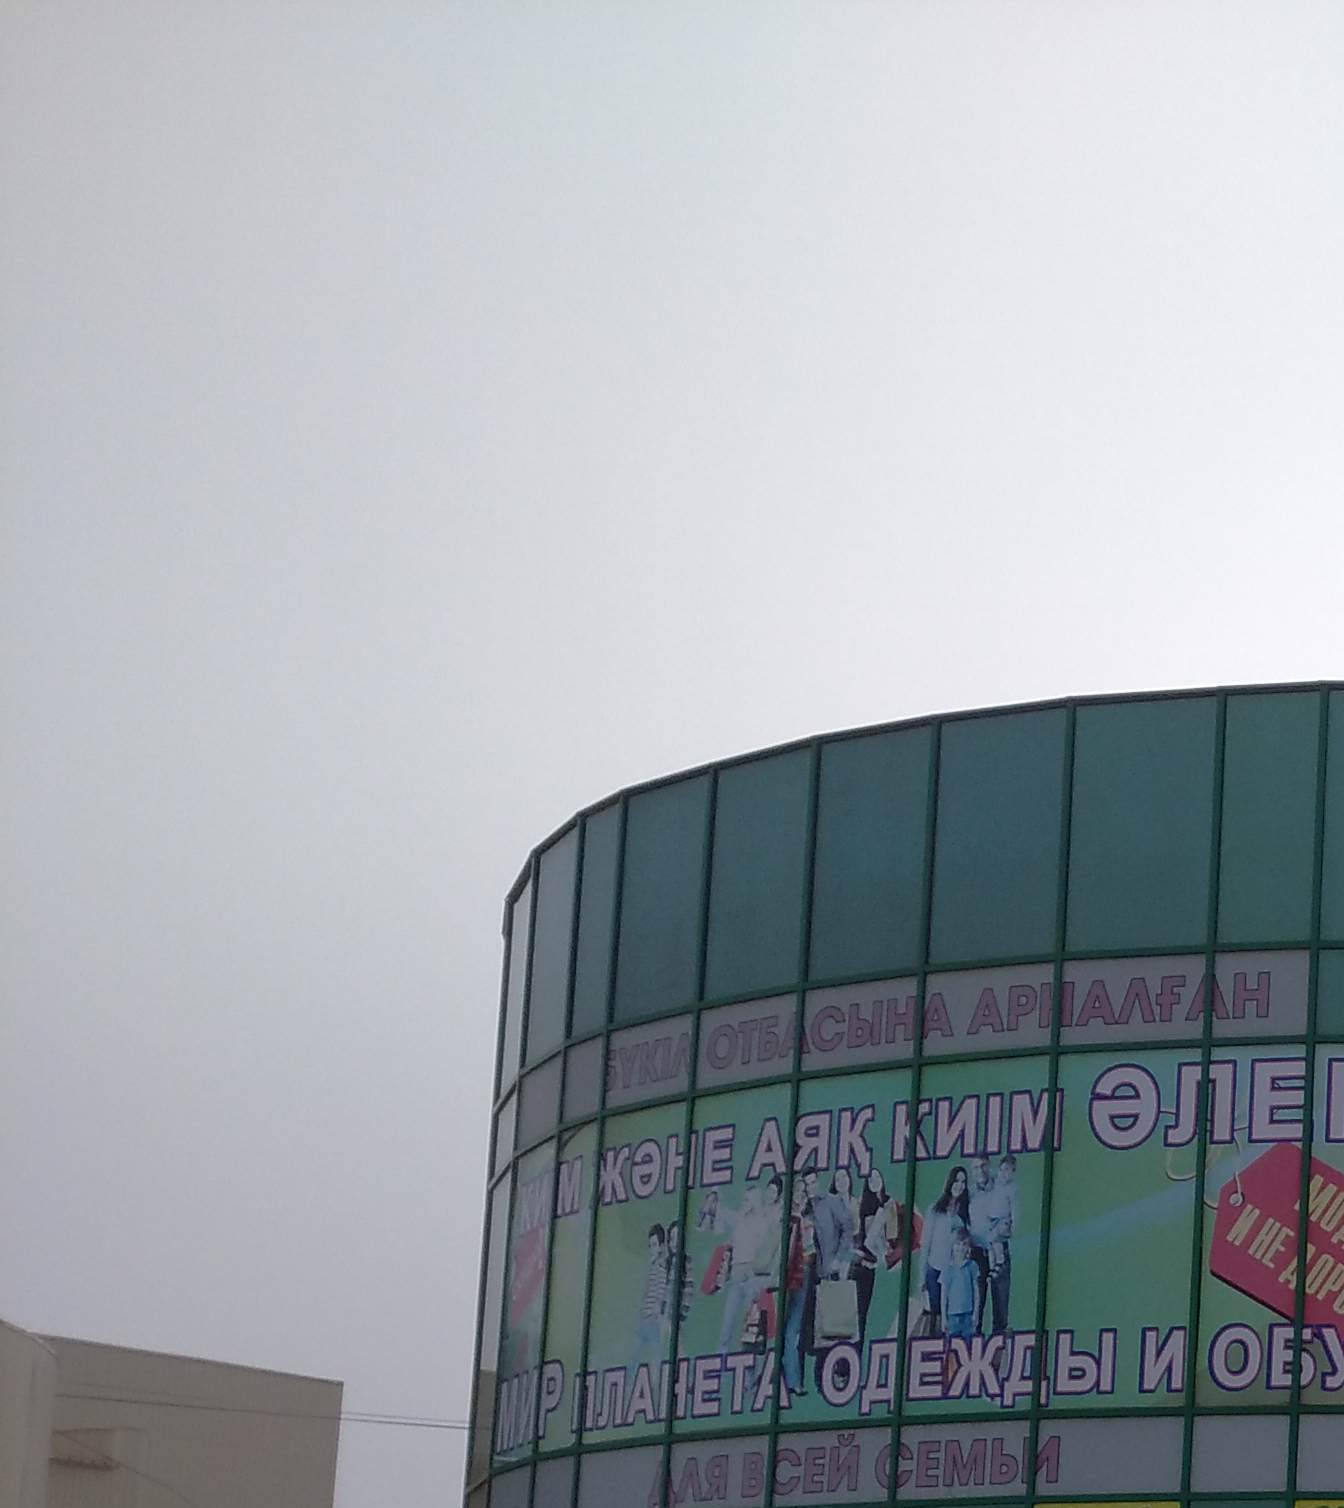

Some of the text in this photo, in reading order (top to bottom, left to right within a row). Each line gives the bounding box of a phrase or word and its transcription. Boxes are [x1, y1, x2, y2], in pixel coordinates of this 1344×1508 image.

[706, 992, 954, 1070] ОТБАСЫНА
[967, 970, 1272, 1036] АРНАЛҒАН
[600, 1124, 736, 1207] ЖӘНЕ
[745, 1104, 874, 1182] АЯҚ
[891, 1087, 1065, 1163] КИІМ
[1226, 1204, 1261, 1246] И
[1248, 1221, 1296, 1269] НЕ
[496, 1359, 565, 1455] МИР
[571, 1349, 792, 1434] ПЛАНЕТА
[822, 1327, 1117, 1416] ОДЕЖДЫ
[1138, 1327, 1187, 1393] И
[740, 1433, 858, 1498] ВСЕЙ
[875, 1435, 1061, 1489] СЕМЬИ
